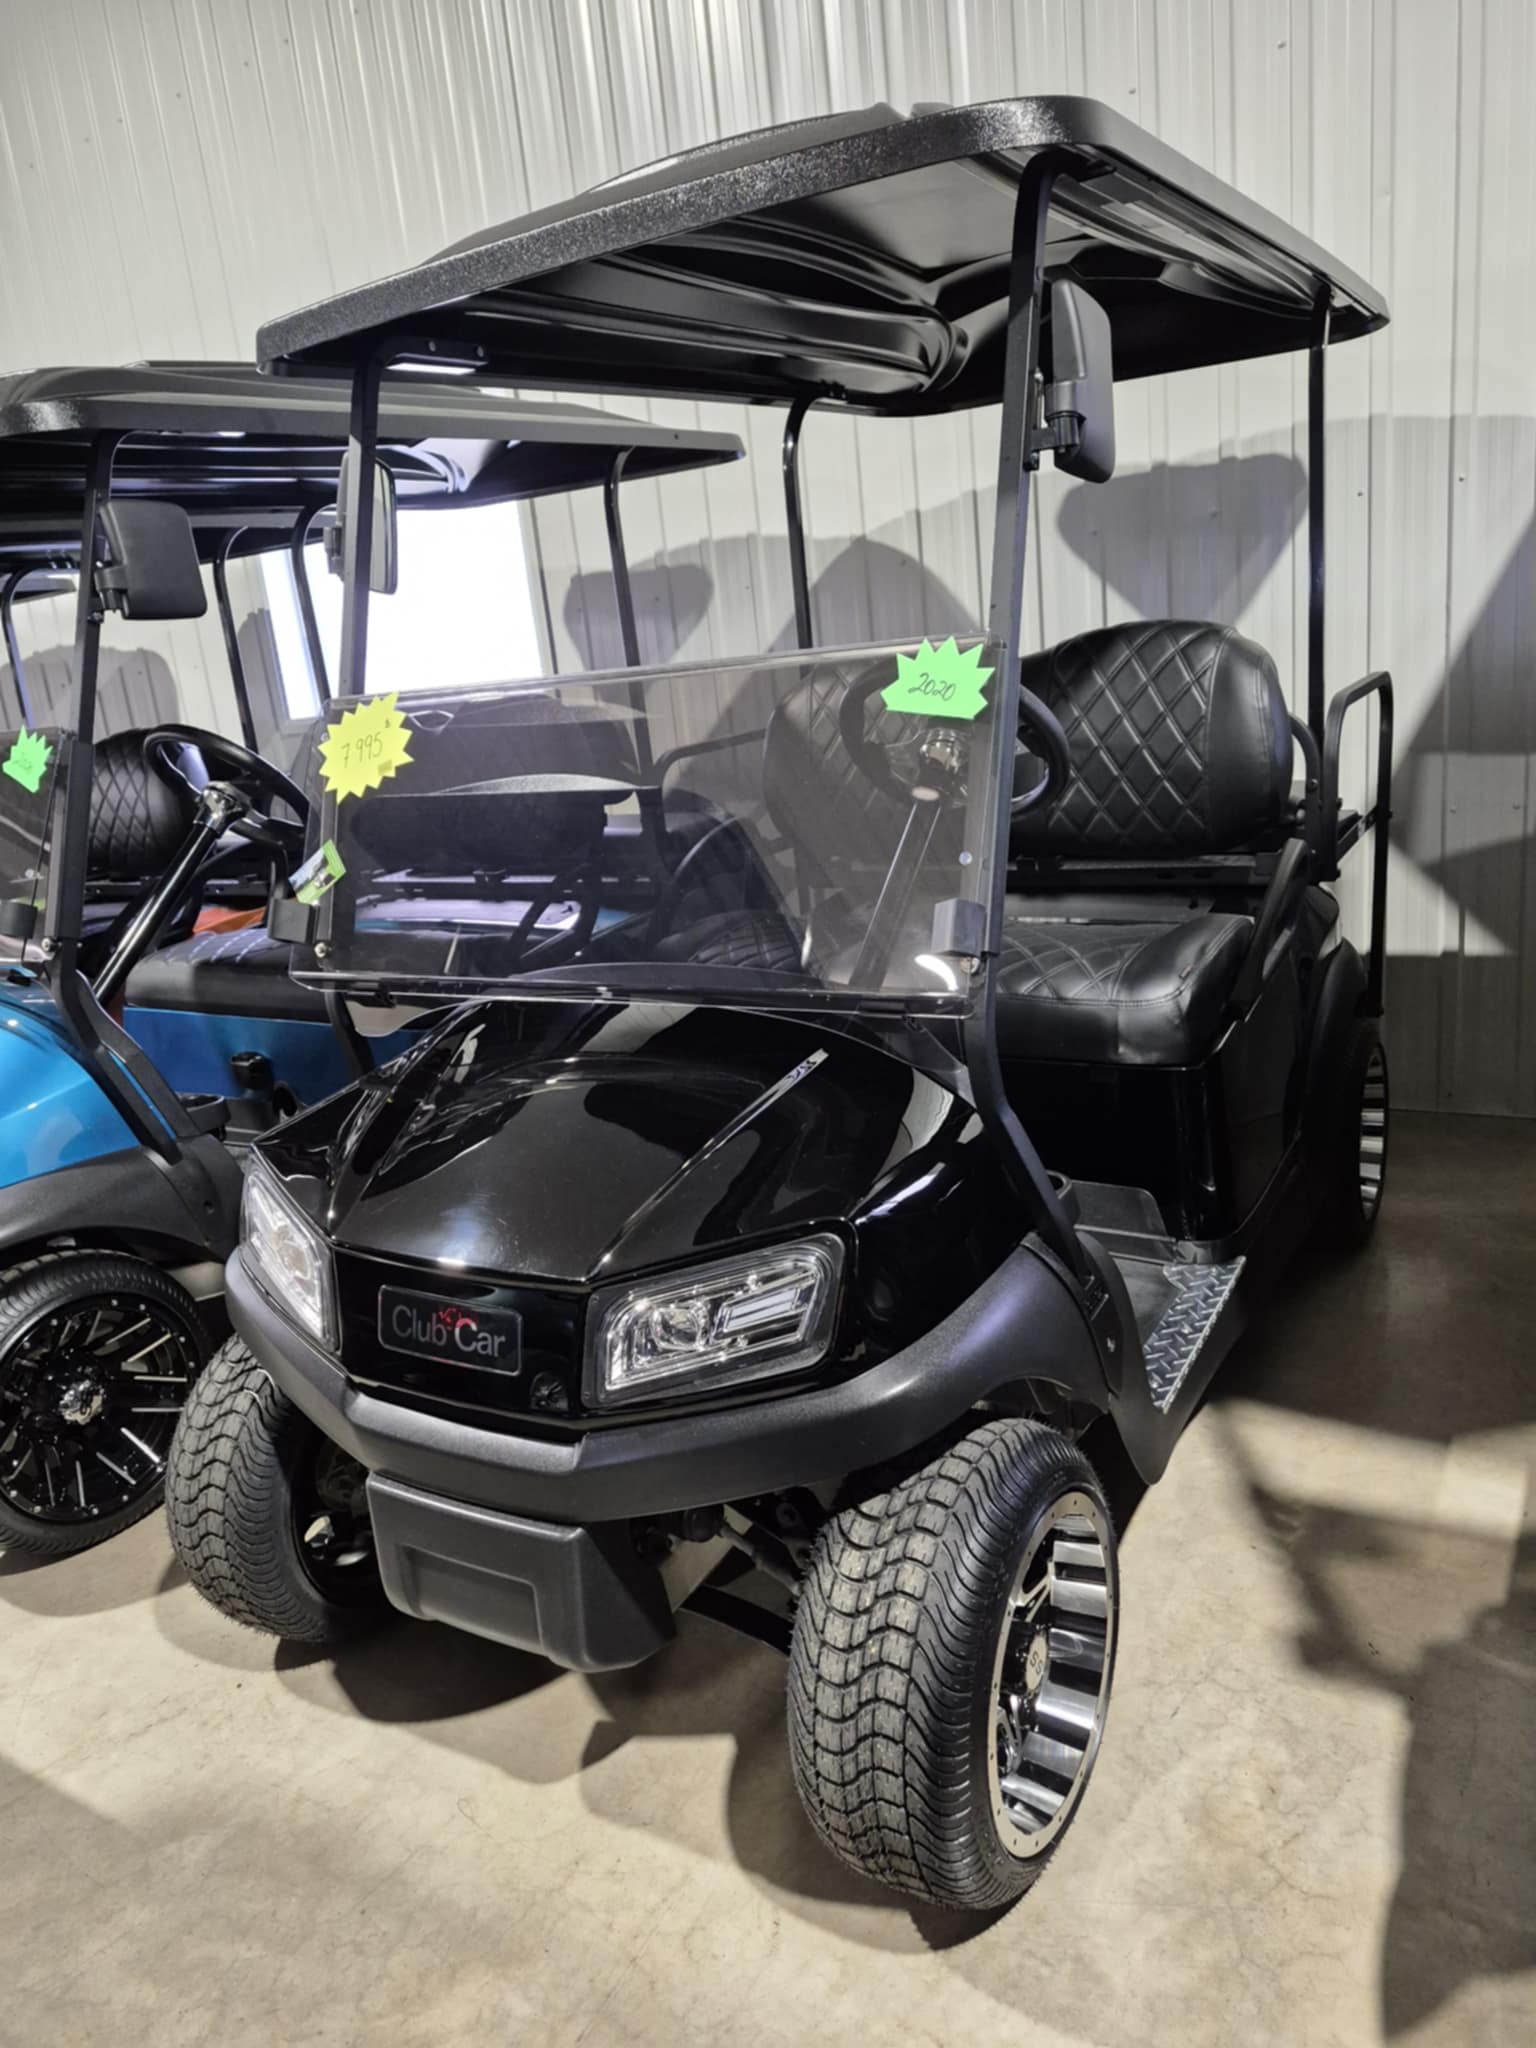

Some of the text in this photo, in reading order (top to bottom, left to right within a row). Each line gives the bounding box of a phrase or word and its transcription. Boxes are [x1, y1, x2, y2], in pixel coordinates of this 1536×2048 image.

[908, 672, 956, 702] 2020
[392, 1304, 506, 1357] Club Car
